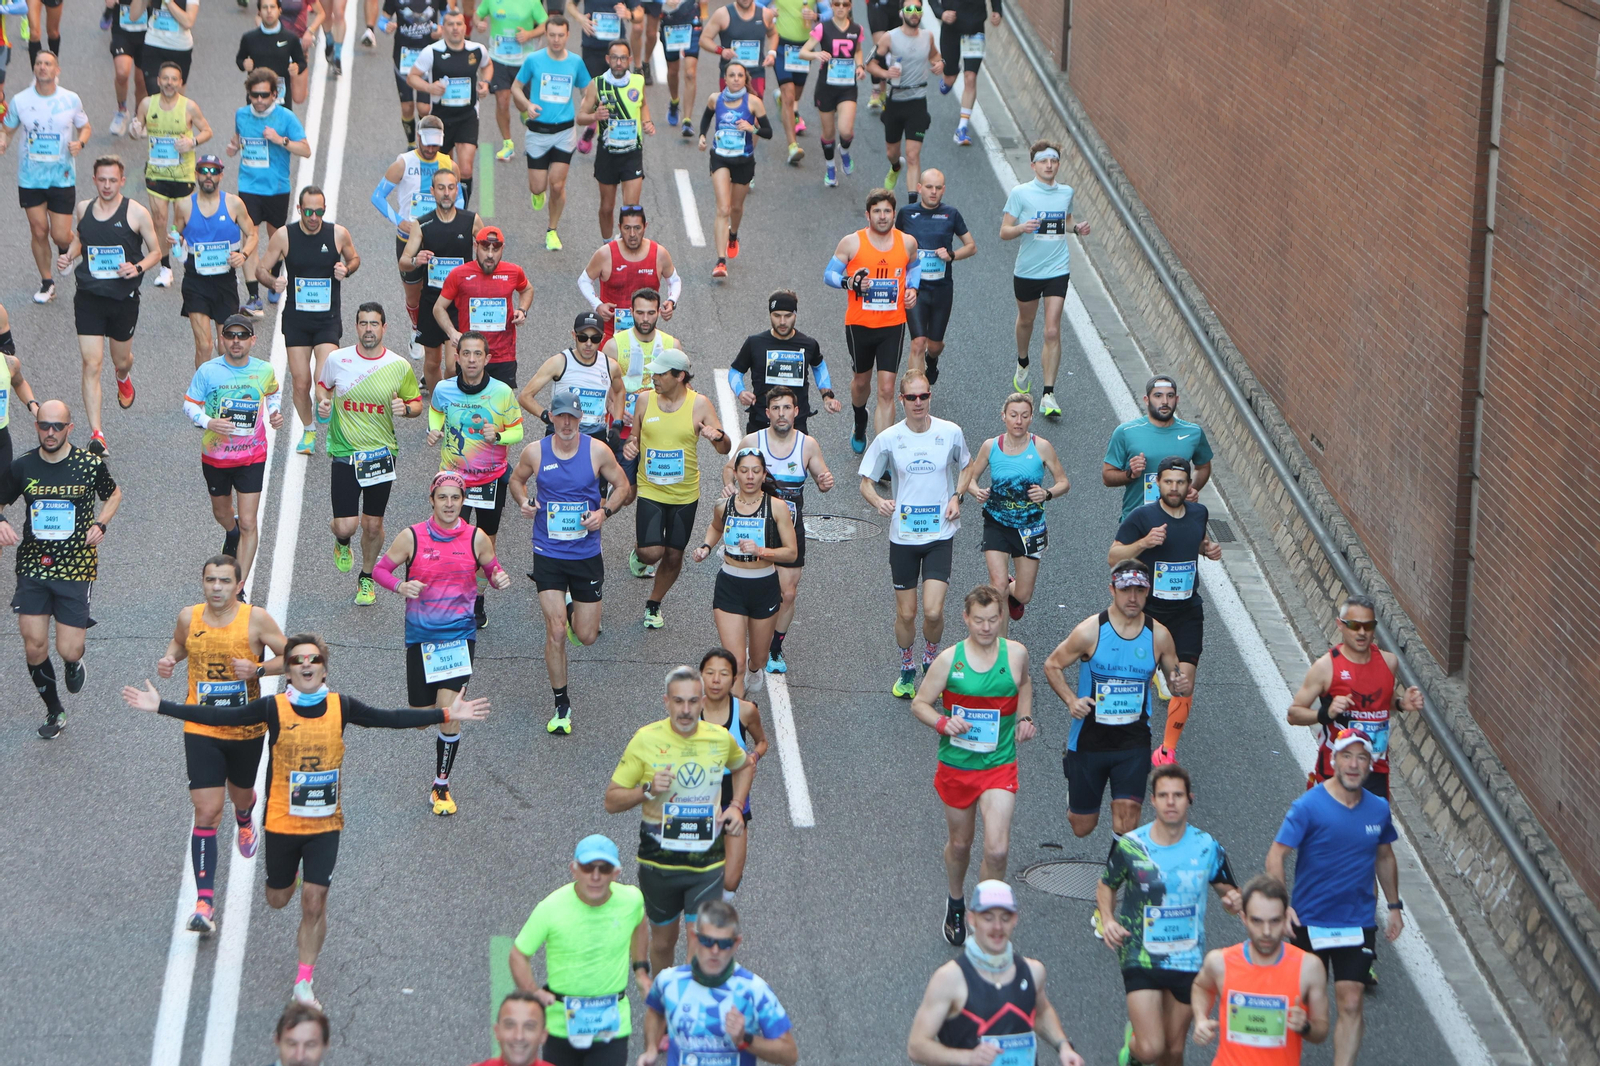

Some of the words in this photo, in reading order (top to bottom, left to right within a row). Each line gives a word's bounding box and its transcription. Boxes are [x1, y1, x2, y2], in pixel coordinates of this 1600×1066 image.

[833, 39, 854, 57] R
[235, 402, 256, 410] ZURICH
[343, 399, 385, 415] ÉLITE
[543, 463, 558, 471] HOKA
[32, 485, 86, 496] BEFASTER
[45, 515, 59, 523] 3491
[436, 640, 461, 650] ZURICH
[440, 655, 453, 663] 5151
[213, 685, 240, 693] ZURICH
[967, 711, 993, 720] ZURICH
[309, 774, 335, 783] ZURICH
[682, 807, 709, 815] ZURICH
[681, 822, 698, 831] 3029
[678, 832, 700, 840] JOSELU
[1163, 909, 1192, 918] ZURICH
[584, 998, 612, 1008] ZURICH
[1247, 998, 1281, 1008] ZURICH
[1002, 1039, 1031, 1049] ZURICH
[700, 1056, 732, 1065] ZURICH
